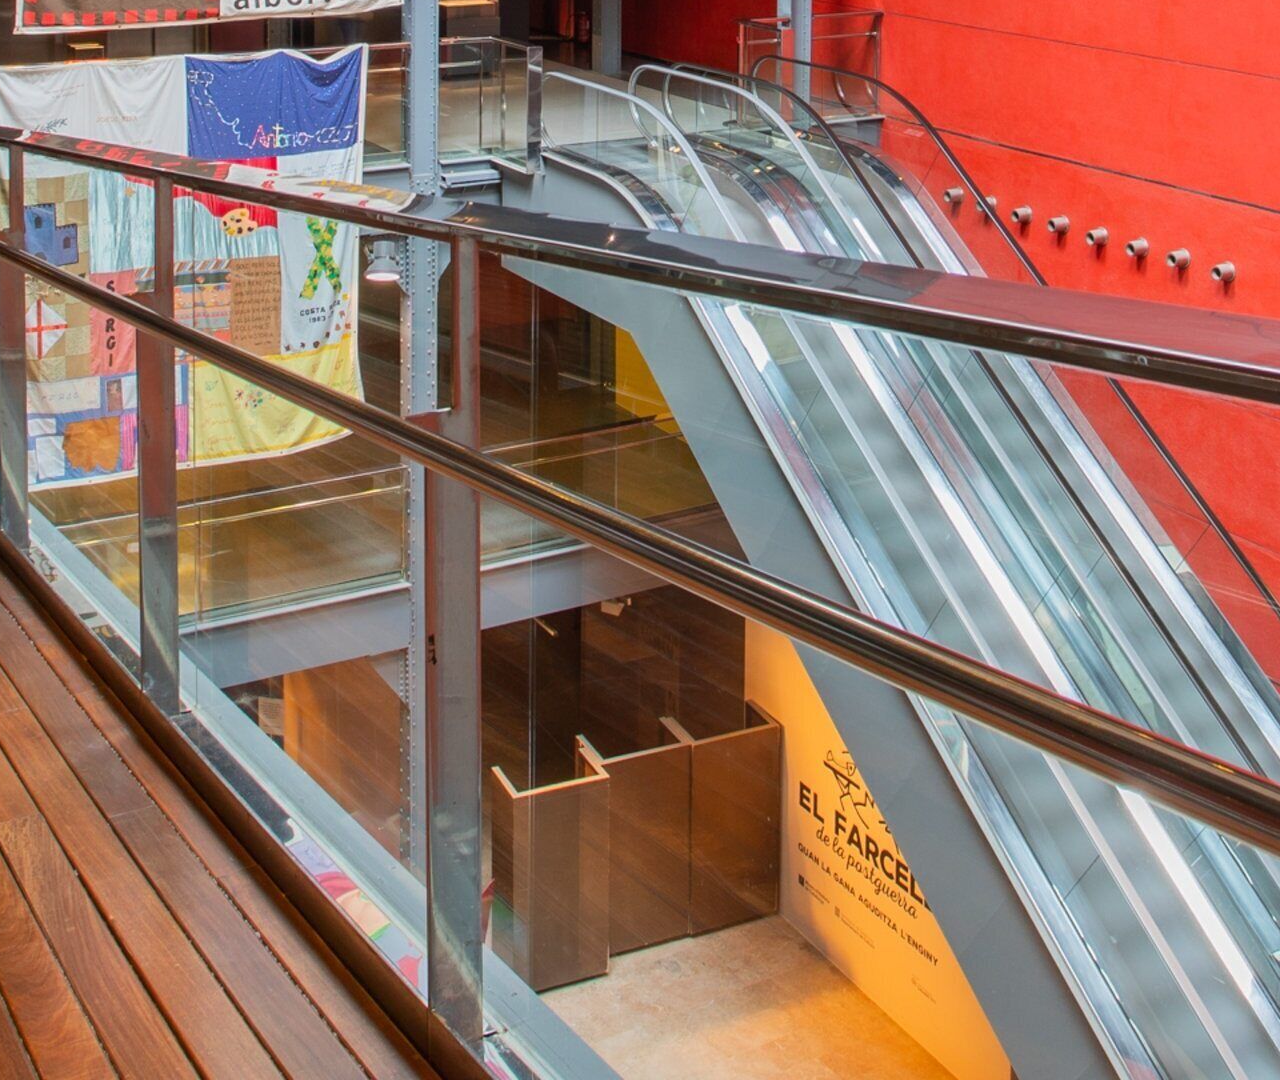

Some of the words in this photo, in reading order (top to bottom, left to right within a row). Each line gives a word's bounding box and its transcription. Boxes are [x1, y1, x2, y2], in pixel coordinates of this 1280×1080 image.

[250, 122, 313, 149] Antonio
[105, 279, 117, 368] SRGI
[299, 306, 326, 317] COSTA
[799, 780, 825, 825] EL
[834, 809, 933, 912] FARCEL
[815, 826, 831, 847] de
[832, 836, 846, 860] la
[846, 854, 918, 920] postguerra
[797, 842, 820, 867] QUAN
[820, 860, 832, 877] LA
[833, 872, 856, 897] GANA
[858, 893, 898, 933] AGUDITZA
[900, 928, 939, 967] L'ENGINY
